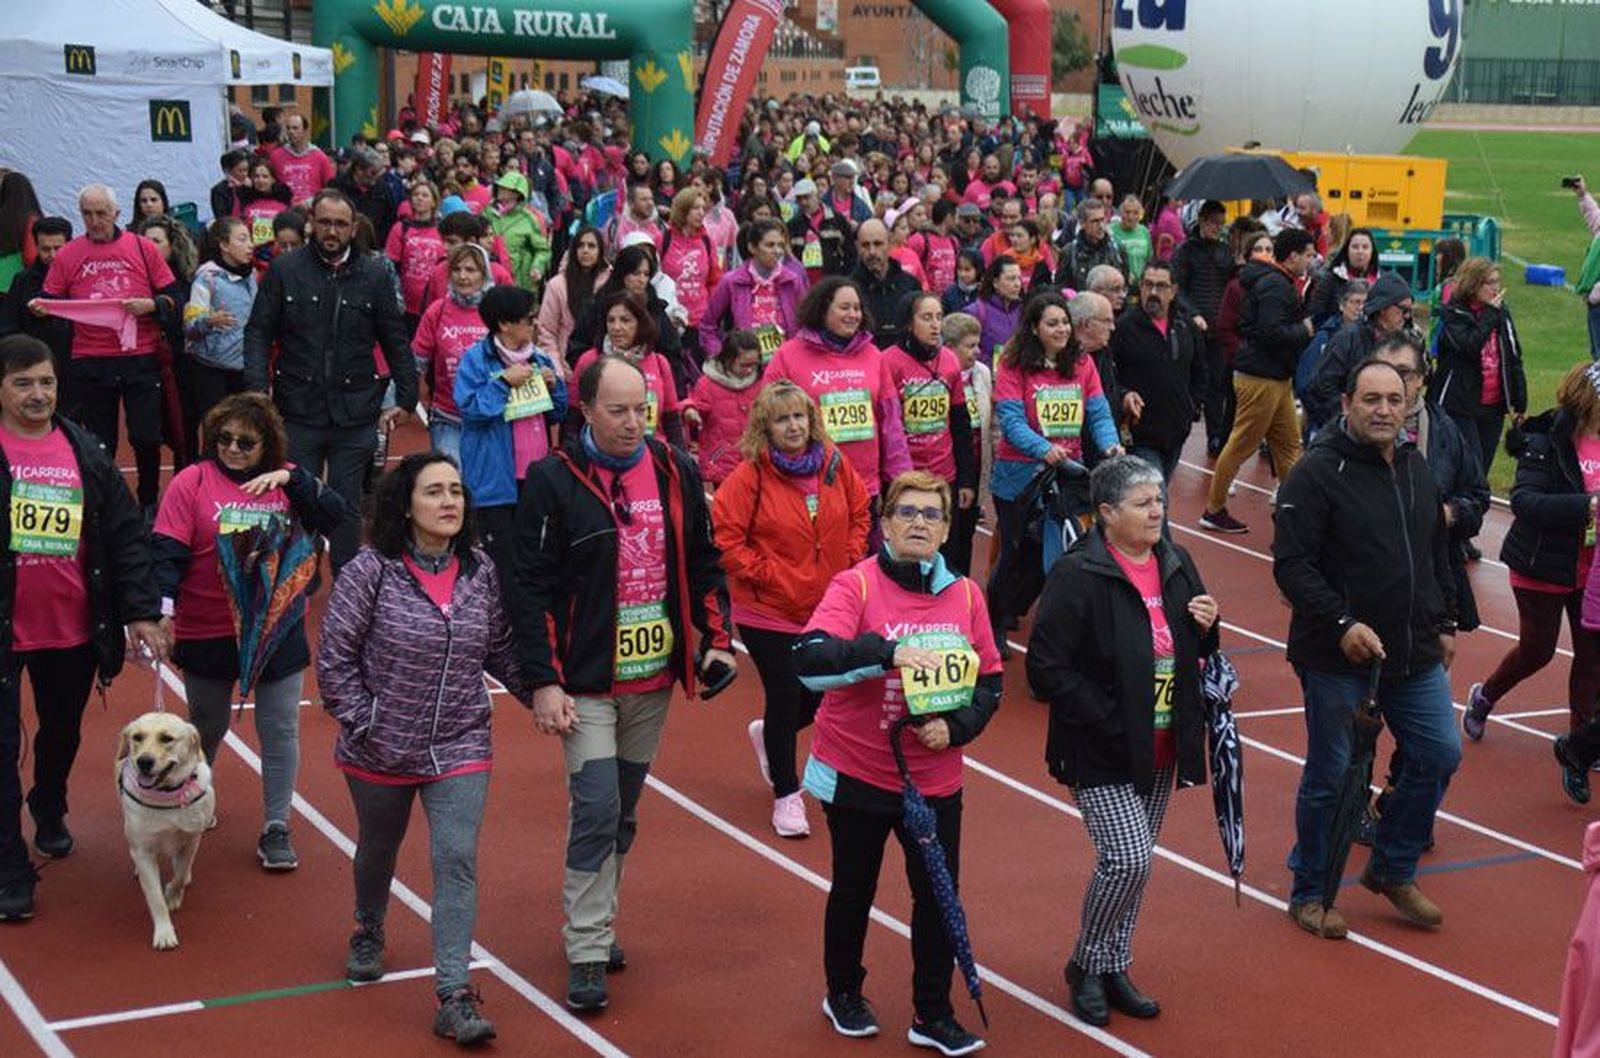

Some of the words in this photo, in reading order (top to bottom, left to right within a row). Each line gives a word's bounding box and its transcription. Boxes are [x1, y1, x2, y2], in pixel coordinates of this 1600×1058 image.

[432, 4, 505, 34] CAJA
[513, 9, 617, 39] RURAL
[728, 14, 761, 65] ZAMORA
[153, 56, 206, 69] SmartChip
[722, 62, 742, 84] DE
[1126, 74, 1197, 119] leche
[827, 403, 868, 427] 4298
[908, 397, 946, 418] 4295
[1041, 402, 1078, 422] 4297
[22, 467, 81, 480] CARRERA
[14, 502, 71, 535] 1879
[619, 624, 664, 657] 509
